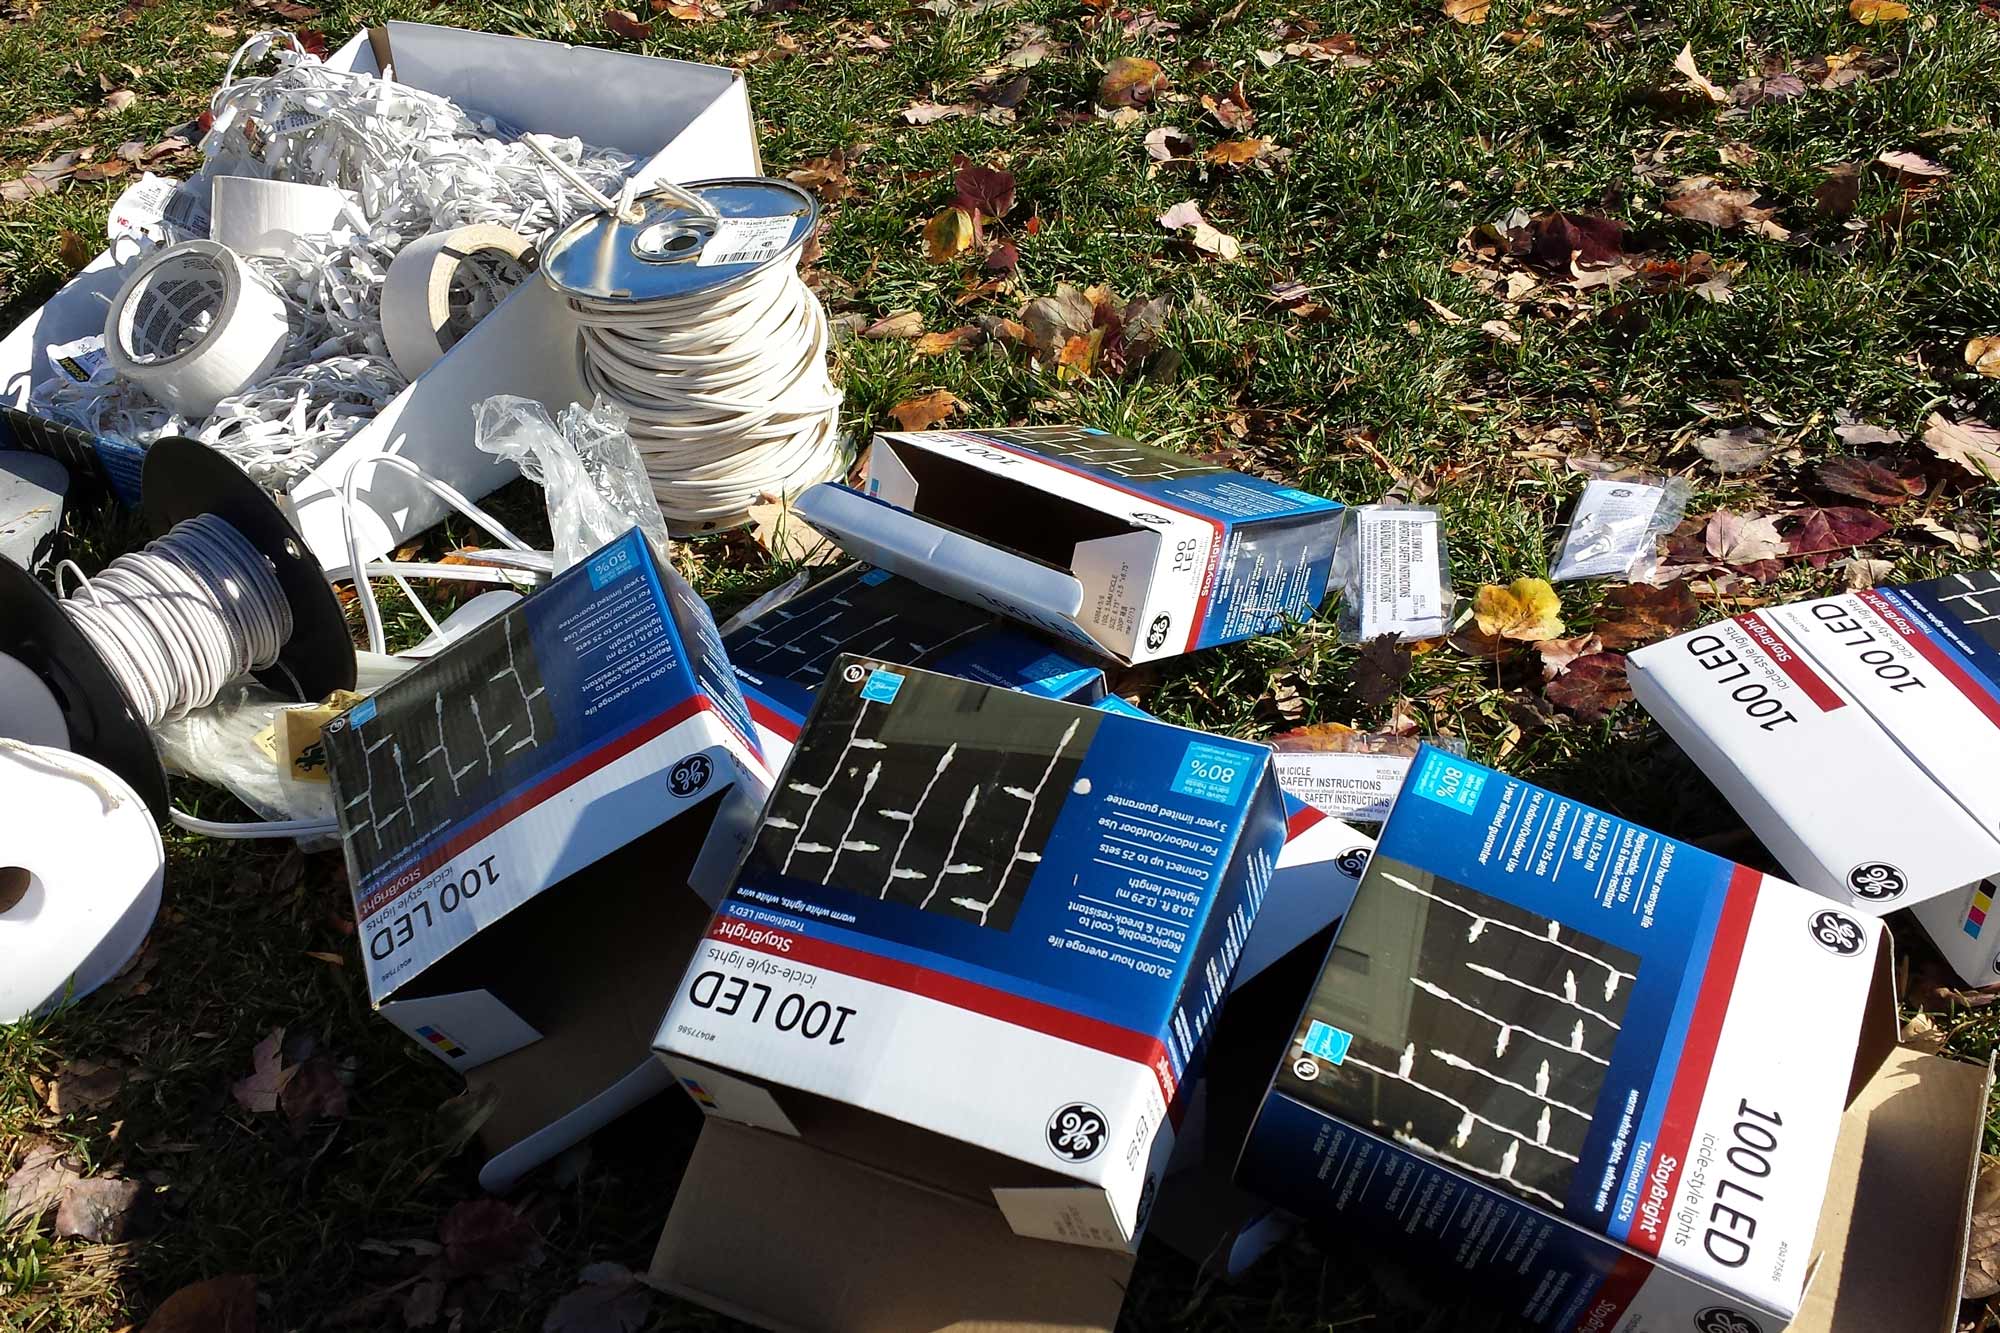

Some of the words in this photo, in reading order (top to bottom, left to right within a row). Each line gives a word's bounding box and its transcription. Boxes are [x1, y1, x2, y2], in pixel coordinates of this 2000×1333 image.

[60, 359, 89, 383] Scotch
[1380, 520, 1390, 531] READ
[1398, 520, 1409, 545] IMPORTANT
[1380, 533, 1390, 549] FOLLOW
[594, 549, 626, 576] 80%
[1172, 538, 1186, 577] 100
[1182, 536, 1197, 576] LED
[1399, 545, 1409, 563] SAFETY
[1380, 558, 1390, 572] SAFETY
[1380, 573, 1390, 602] INSTRUCTIONS
[1399, 564, 1410, 597] INSTRUCTIONS
[1845, 597, 1872, 620] lights
[1884, 591, 1903, 606] LED's
[634, 617, 661, 635] lighted
[1808, 600, 1876, 651] LED
[1898, 605, 1932, 634] Traditional
[608, 632, 633, 650] length
[646, 638, 669, 655] touch
[1722, 625, 1749, 650] lights
[1868, 619, 1914, 660] icicle-style
[621, 644, 671, 673] Replaceable,
[639, 651, 646, 659] &
[1681, 630, 1751, 686] LED
[581, 655, 639, 692] break-resistant
[650, 659, 677, 679] 20,000
[1744, 647, 1790, 691] icicle-style
[1857, 644, 1926, 701] 100
[604, 673, 621, 686] cool
[630, 675, 649, 689] hour
[597, 686, 629, 707] average
[584, 705, 597, 715] life
[1728, 679, 1798, 736] 100
[1187, 759, 1236, 783] 80%
[1286, 767, 1310, 775] ICICLE
[1280, 776, 1313, 786] SAFETY
[1316, 778, 1381, 790] INSTRUCTIONS
[1435, 765, 1463, 800] 80%
[1304, 793, 1335, 803] SAFETY
[1334, 795, 1390, 807] INSTRUCTIONS
[1501, 785, 1513, 802] year
[1531, 791, 1543, 803] For
[1097, 817, 1118, 829] Use
[1158, 807, 1194, 823] limited
[1194, 817, 1219, 828] year
[1492, 802, 1509, 827] limited
[1551, 801, 1570, 831] Connect
[1580, 811, 1596, 837] lighted
[1118, 822, 1199, 851] Indoor/Outdoor
[1219, 823, 1227, 832] 3
[1510, 803, 1539, 858] Indoor/Outdoor
[1545, 830, 1557, 841] up
[1544, 840, 1555, 849] to
[1622, 827, 1636, 849] touch
[1098, 843, 1121, 854] sets
[1121, 849, 1136, 860] 25
[1136, 853, 1149, 864] to
[1200, 844, 1218, 856] For
[1541, 849, 1552, 860] 25
[1572, 836, 1588, 861] length
[1619, 847, 1629, 855] &
[1623, 831, 1648, 875] Replaceable,
[1659, 842, 1674, 868] 20,000
[1149, 854, 1164, 866] up
[1164, 860, 1209, 880] Connect
[1505, 857, 1519, 873] Use
[1535, 859, 1546, 875] sets
[437, 853, 501, 917] 100
[1127, 877, 1162, 894] length
[1602, 854, 1627, 909] break-resistant
[1620, 876, 1631, 894] cool
[1653, 866, 1667, 885] hour
[396, 865, 454, 910] icicle-style
[736, 887, 755, 897] wire
[755, 892, 779, 902] white
[1115, 888, 1130, 897] m)
[1162, 887, 1200, 904] lighted
[1617, 892, 1628, 902] to
[780, 896, 805, 911] lights,
[805, 904, 830, 915] white
[1130, 892, 1158, 907] (3.29
[1159, 899, 1171, 910] ft.
[1643, 884, 1660, 915] average
[365, 905, 395, 931] lights
[728, 904, 754, 918] LED's
[829, 910, 856, 922] warm
[1066, 901, 1144, 930] break-resistant
[1170, 903, 1194, 917] 10.8
[753, 911, 806, 931] Traditional
[1078, 916, 1090, 926] to
[1090, 919, 1114, 931] cool
[1144, 923, 1154, 932] &
[1640, 914, 1653, 928] life
[368, 899, 432, 965] LED
[1047, 935, 1064, 947] life
[1116, 924, 1182, 952] Replaceable,
[1154, 926, 1186, 941] touch
[706, 947, 744, 968] lights
[1064, 939, 1108, 958] average
[1109, 952, 1135, 968] hour
[1134, 960, 1173, 979] 20,000
[745, 958, 817, 988] icicle-style
[684, 967, 773, 1023] LED
[770, 991, 856, 1047] 100
[676, 1023, 716, 1043] #0477586
[1624, 1088, 1639, 1114] warm
[1617, 1114, 1631, 1138] white
[1723, 1097, 1786, 1180] 100
[1606, 1138, 1626, 1163] lights,
[1626, 1140, 1651, 1193] Traditional
[1685, 1132, 1719, 1205] icicle-style
[1601, 1164, 1615, 1191] white
[1594, 1190, 1608, 1212] wire
[1617, 1192, 1635, 1221] LED's
[1674, 1206, 1699, 1247] lights
[1700, 1178, 1764, 1273] LED
